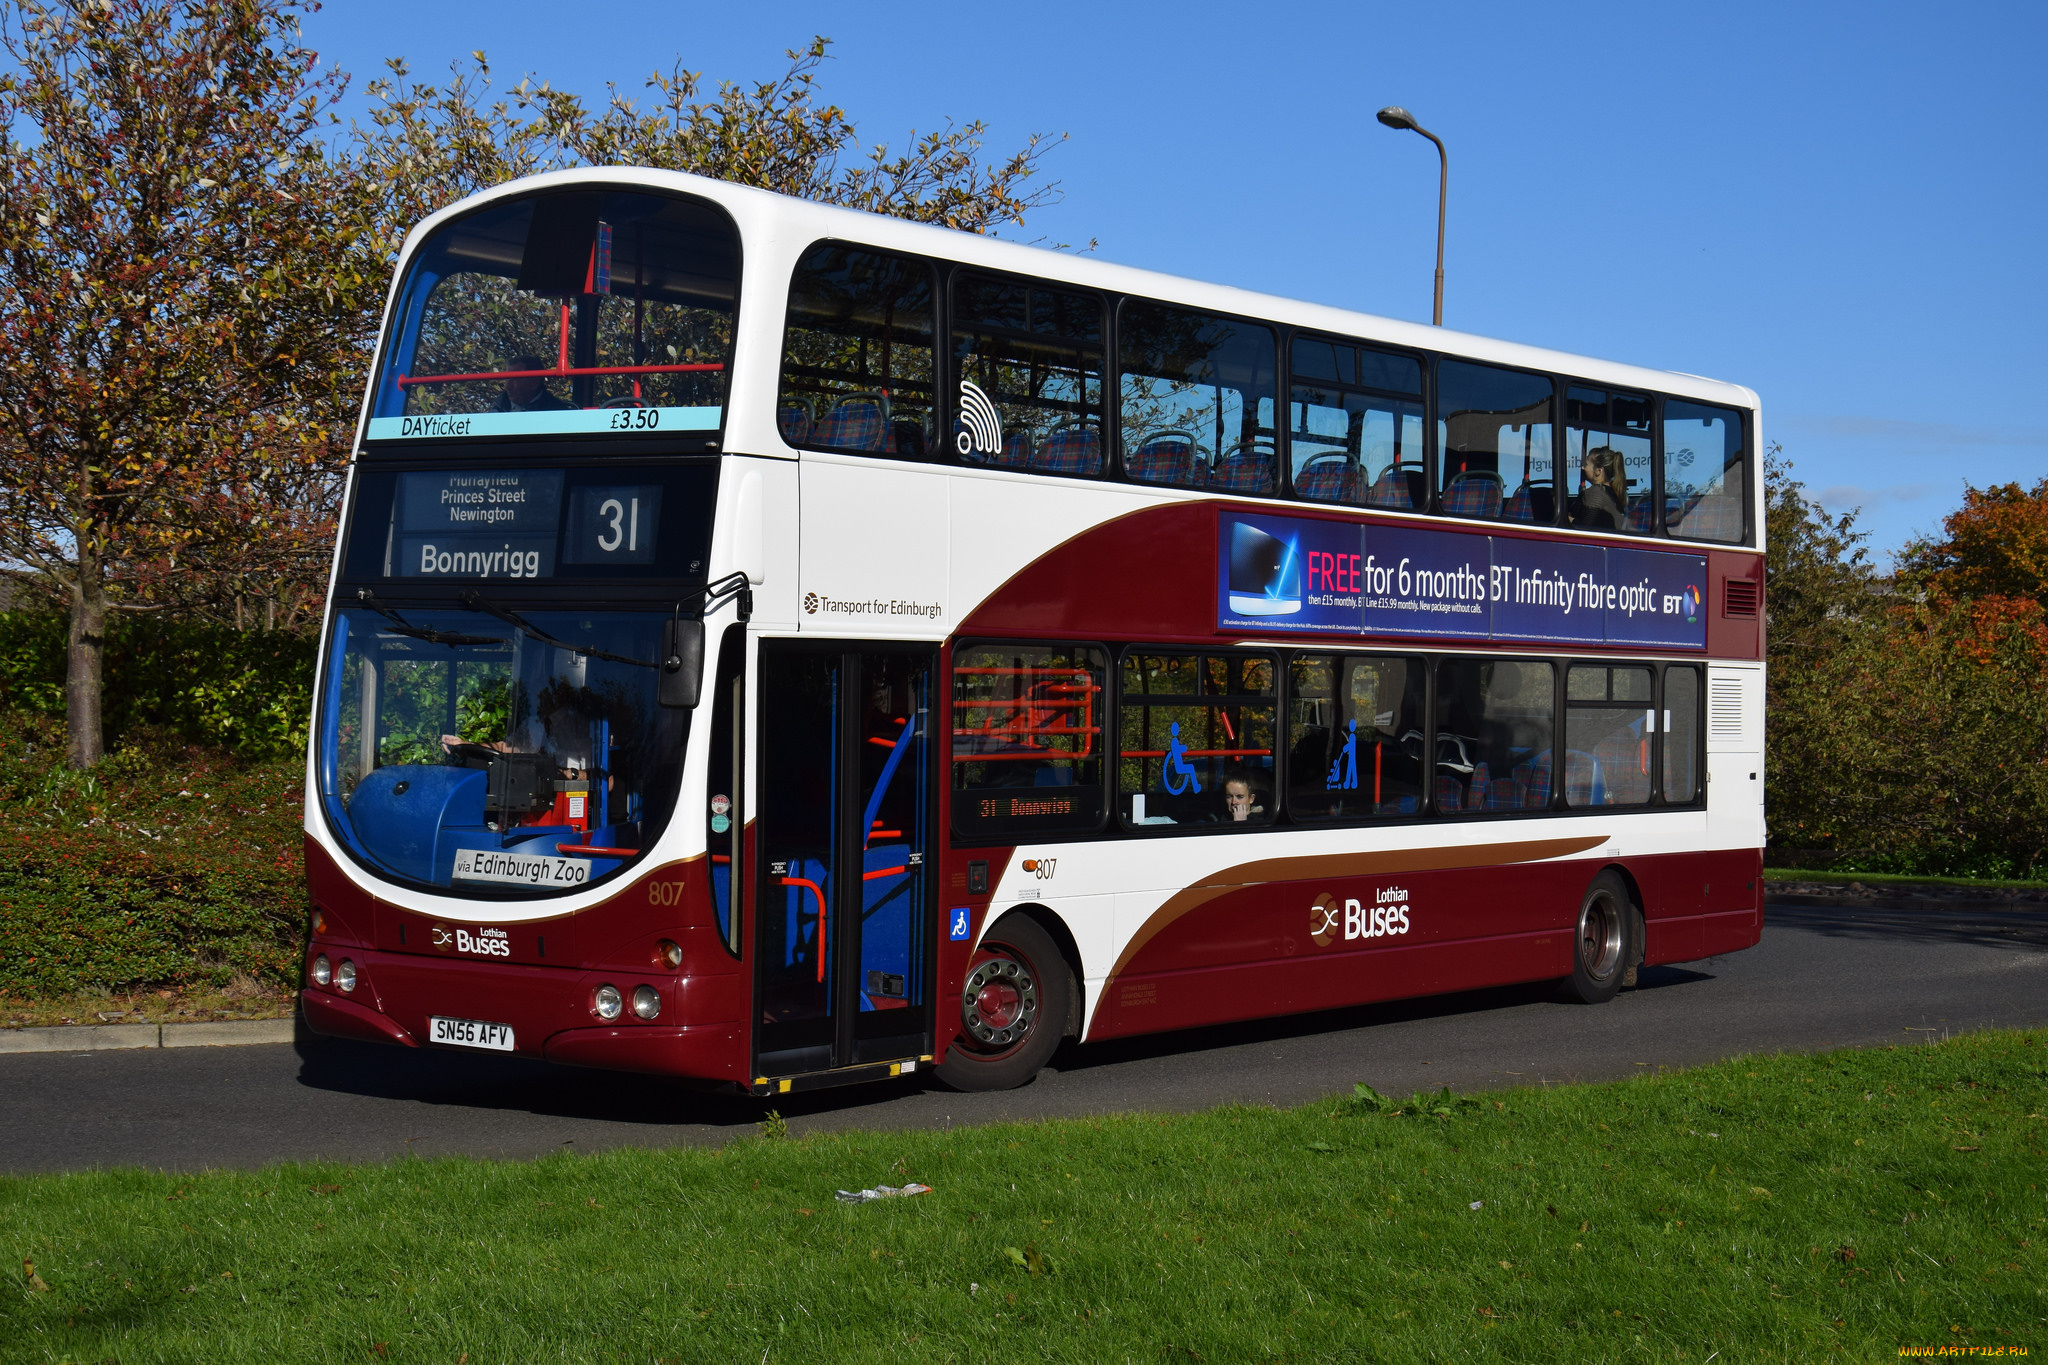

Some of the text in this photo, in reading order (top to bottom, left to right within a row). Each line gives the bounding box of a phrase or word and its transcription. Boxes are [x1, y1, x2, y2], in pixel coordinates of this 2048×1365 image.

[401, 415, 471, 436] DAYticket
[610, 409, 659, 430] £3.50
[441, 487, 526, 504] Princes Street
[450, 506, 514, 524] Newington
[597, 497, 638, 552] 31
[420, 544, 540, 578] Bonnyrigg
[1307, 550, 1657, 618] FREE for 6 months BT Infinity fibre optic
[821, 597, 942, 619] Transport for Edinburgh
[1308, 595, 1321, 605] then
[1322, 595, 1333, 606] £15
[1334, 596, 1357, 608] monthly.
[1366, 597, 1377, 608] Line
[1378, 598, 1397, 609] £15.99
[1398, 600, 1419, 611] monthly.
[1420, 600, 1431, 611] New
[1431, 602, 1451, 613] package
[1451, 602, 1471, 613] without
[1663, 595, 1683, 614] BT
[980, 799, 996, 817] 31
[457, 853, 585, 883] via Edinburgh Zoo
[1036, 859, 1057, 881] 807
[648, 881, 685, 907] 807
[1376, 886, 1408, 904] Lothian
[1345, 898, 1410, 941] Buses
[456, 929, 510, 957] Buses
[480, 926, 507, 939] Lothian
[436, 1018, 508, 1046] SN56 AFV
